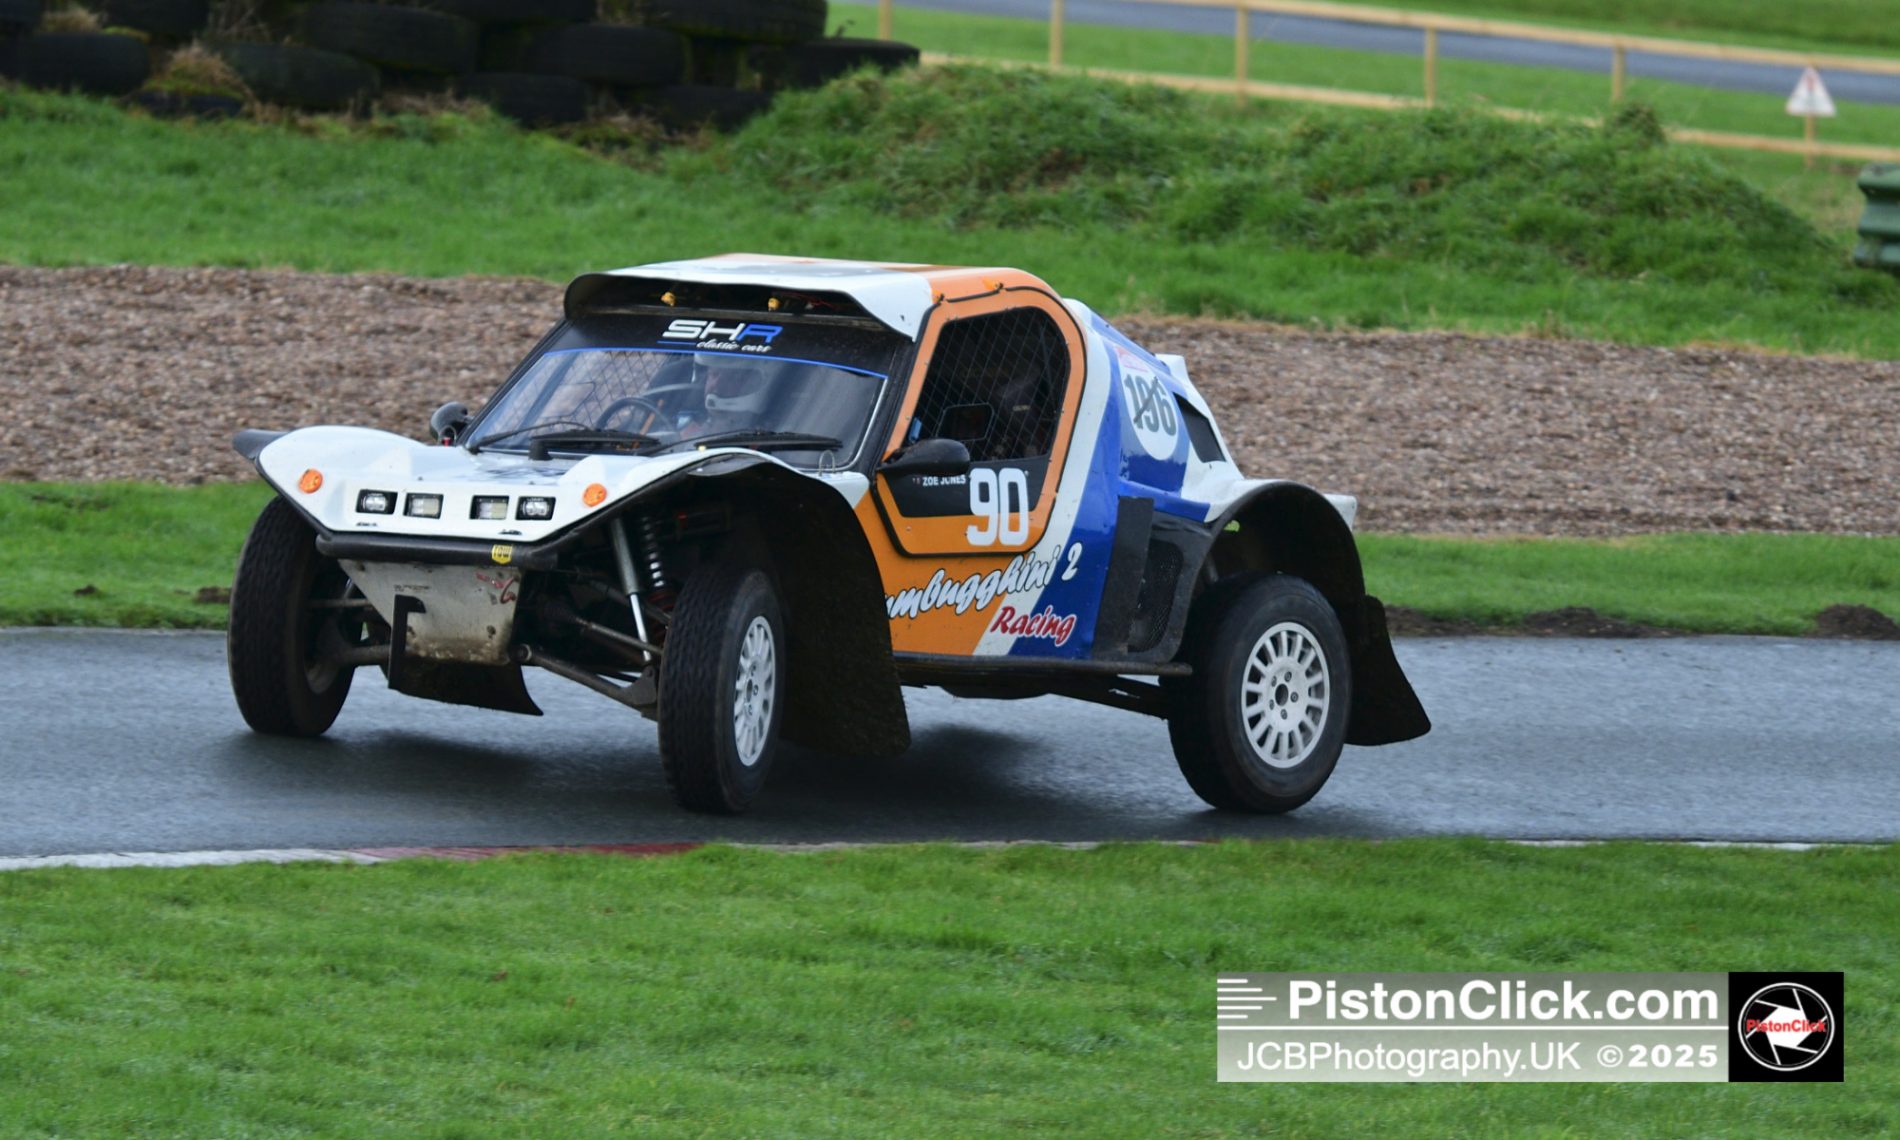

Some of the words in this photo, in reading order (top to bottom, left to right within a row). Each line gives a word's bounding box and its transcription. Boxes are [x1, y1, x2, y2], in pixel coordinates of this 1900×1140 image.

[696, 339, 740, 351] classic
[741, 344, 773, 353] cars
[922, 476, 939, 487] ZOE
[966, 467, 1029, 546] 90
[1061, 541, 1083, 581] 2
[989, 604, 1077, 647] Racing
